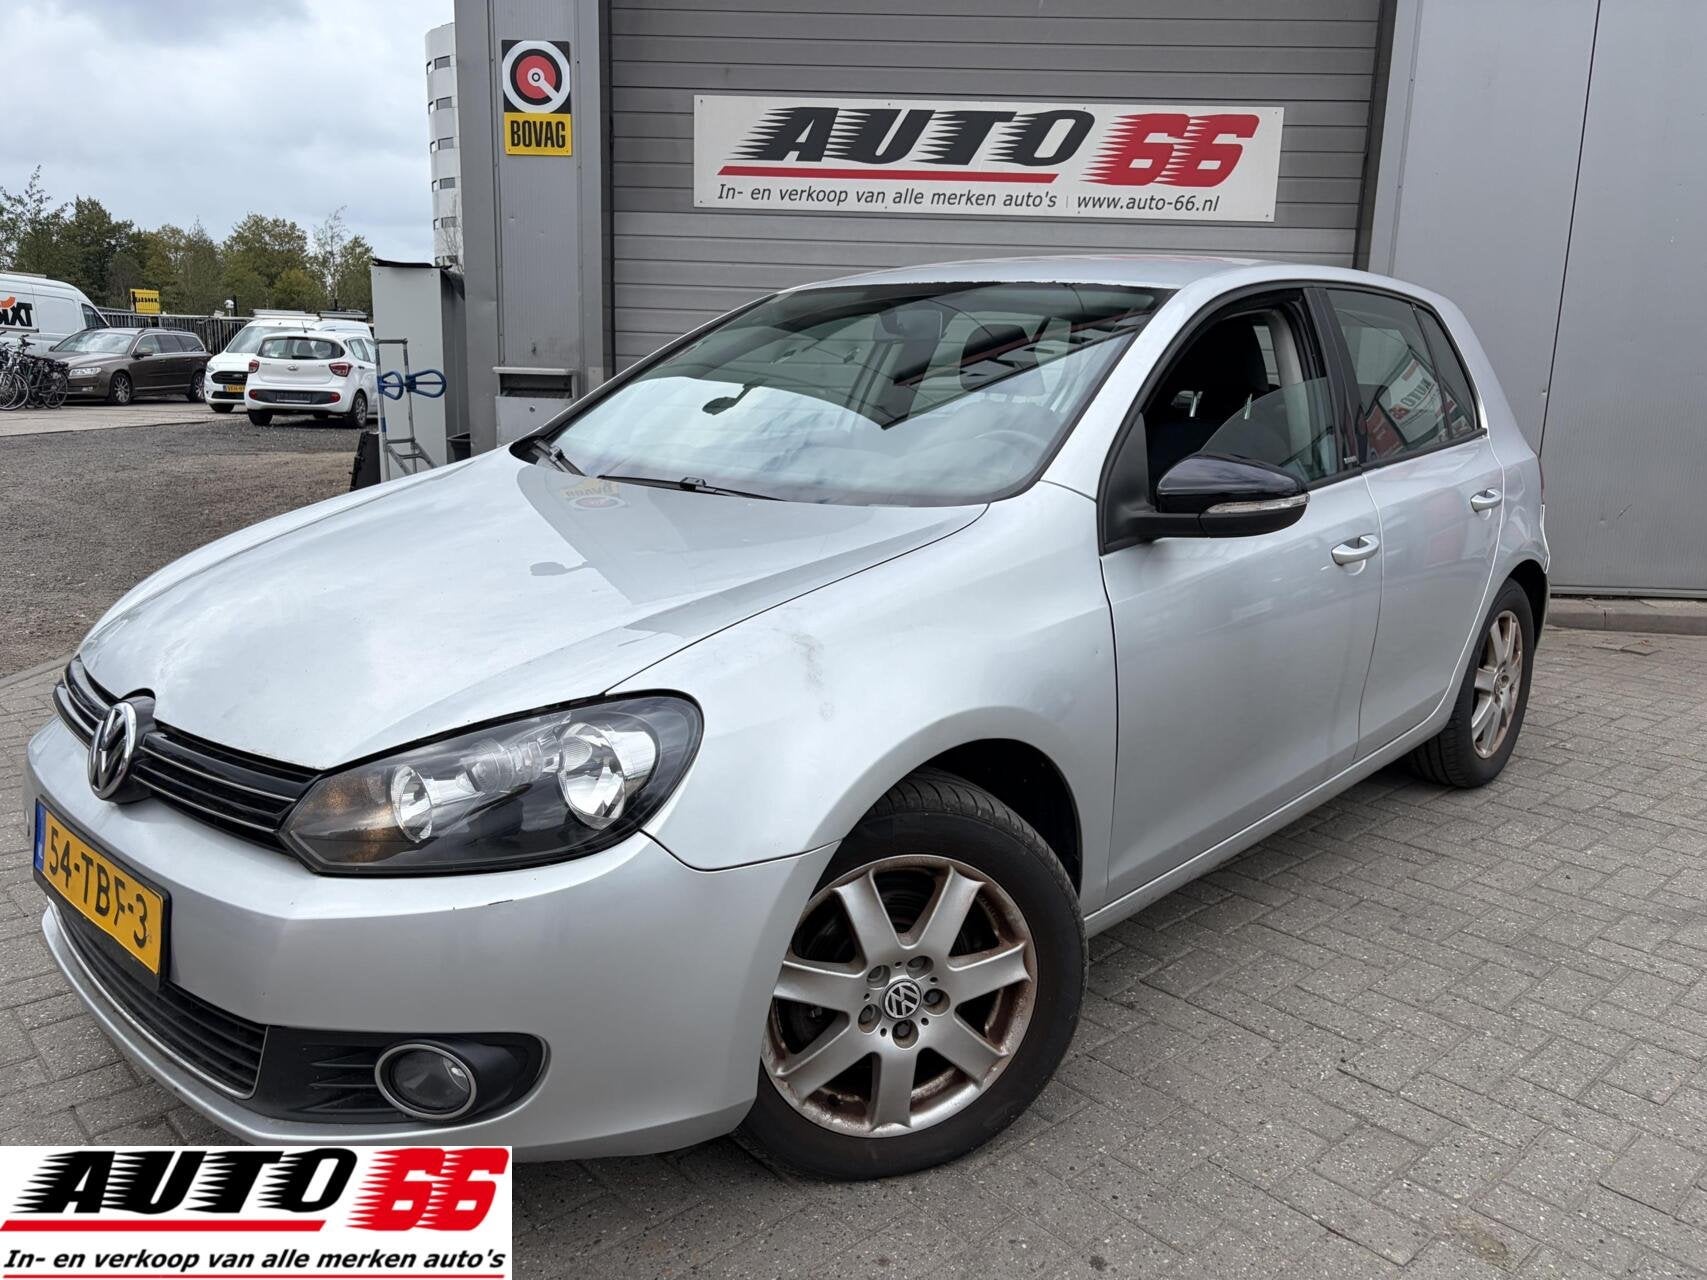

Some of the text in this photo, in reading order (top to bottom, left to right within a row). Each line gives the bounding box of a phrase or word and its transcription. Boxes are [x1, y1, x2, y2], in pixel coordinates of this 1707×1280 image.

[510, 120, 566, 148] BOVAG
[723, 106, 1259, 188] AUTO 66
[717, 183, 1220, 212] In- en verkoop van alle merken auto's www.auto-66.nl
[50, 827, 149, 948] 54-TBF-3
